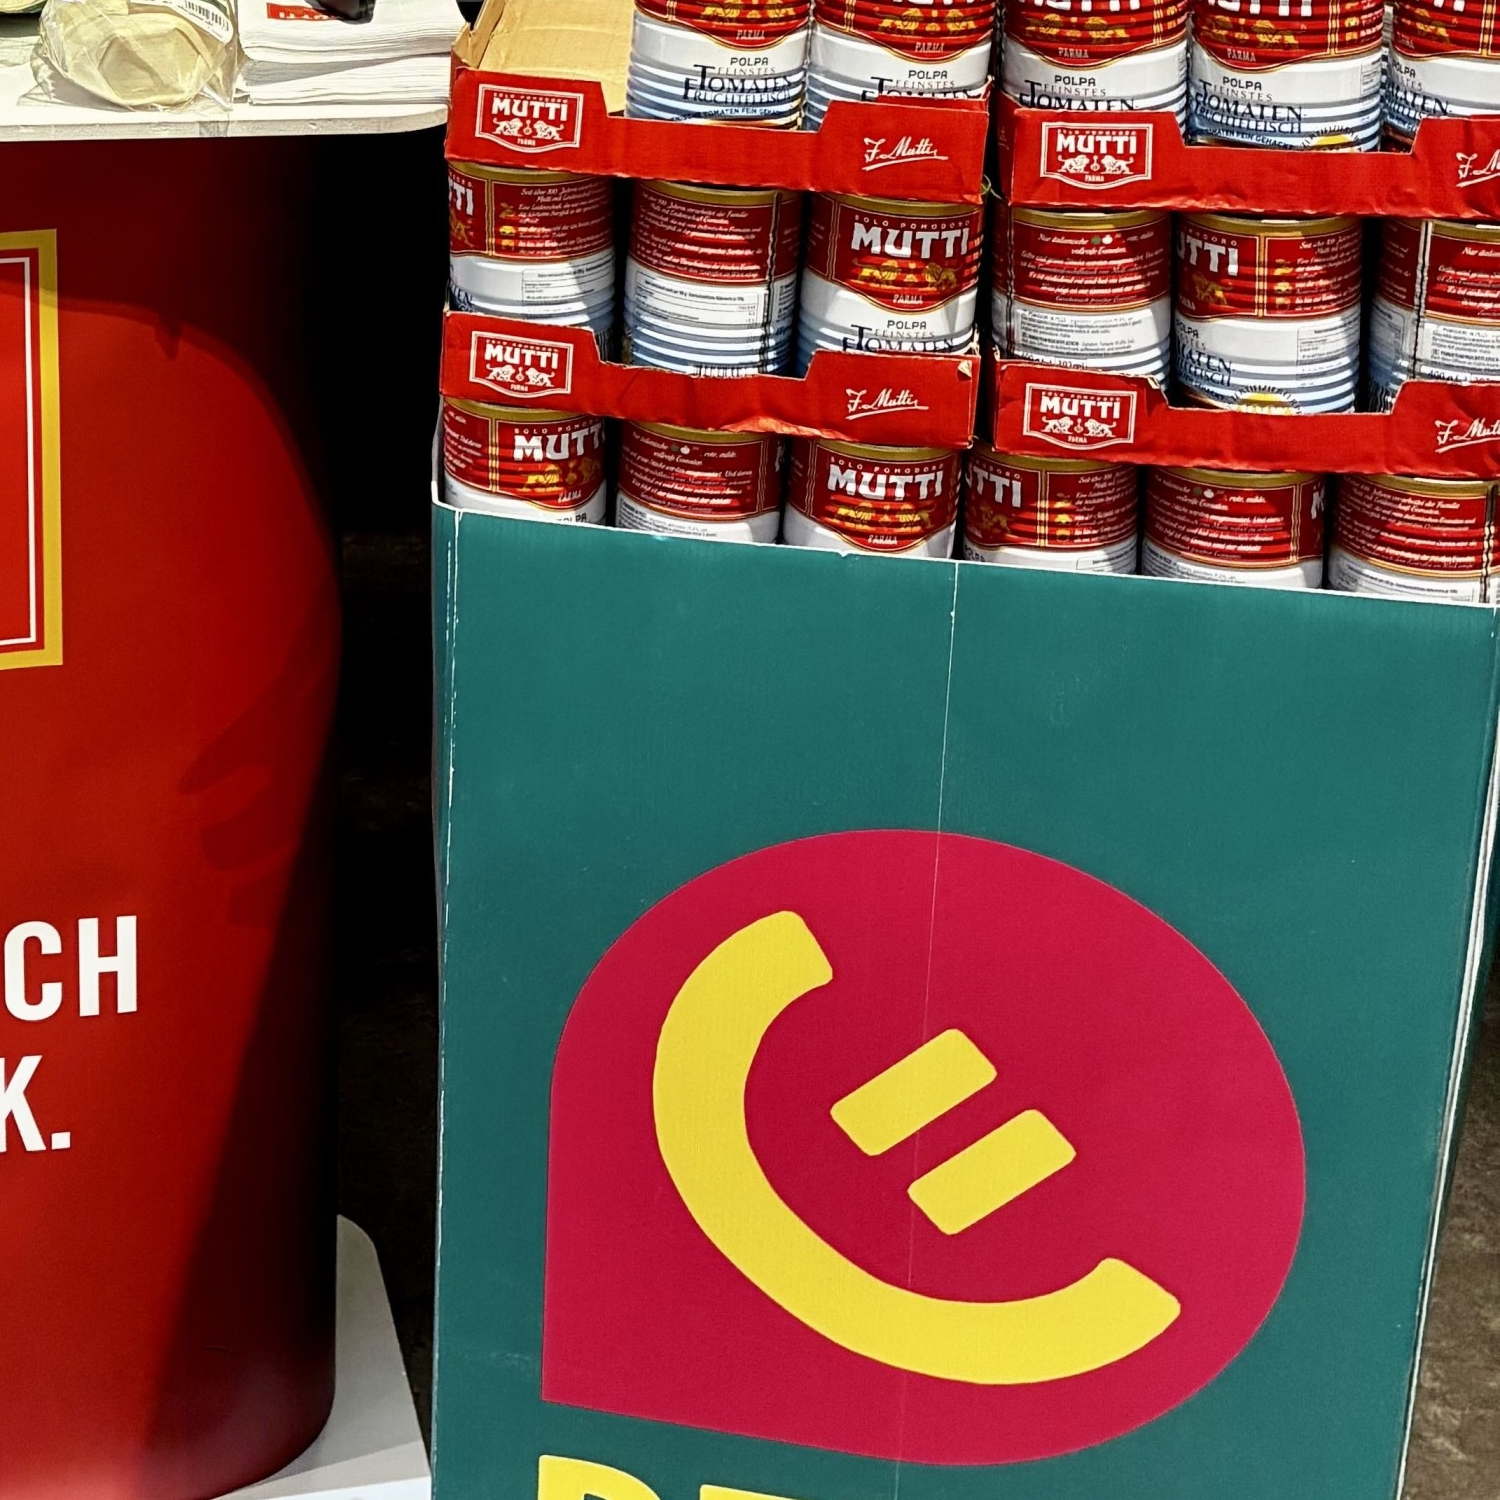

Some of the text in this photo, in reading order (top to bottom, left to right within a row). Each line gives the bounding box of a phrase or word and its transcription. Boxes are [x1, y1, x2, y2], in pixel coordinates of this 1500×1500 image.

[1058, 46, 1090, 60] PARMA
[1227, 47, 1257, 62] PARMA
[730, 57, 769, 67] POLPA
[717, 66, 776, 76] FEINSTES
[908, 69, 948, 80] POLPA
[693, 64, 792, 94] TOMATEN
[894, 78, 956, 89] FEINSTES
[1055, 74, 1097, 86] POLPA
[1222, 76, 1263, 92] POLPA
[1043, 82, 1107, 97] FEINSTES
[491, 97, 568, 122] MUTTI
[1056, 132, 1137, 154] MUTTI
[854, 214, 890, 227] SOLO
[851, 221, 970, 259] MUTTI
[886, 319, 927, 330] POLPA
[874, 328, 935, 338] FEINSTES
[484, 341, 559, 369] MUTTI
[1040, 394, 1121, 419] MUTTI
[513, 424, 605, 461] MUTT
[830, 456, 864, 470] SOLO
[827, 463, 944, 501] MUTTI
